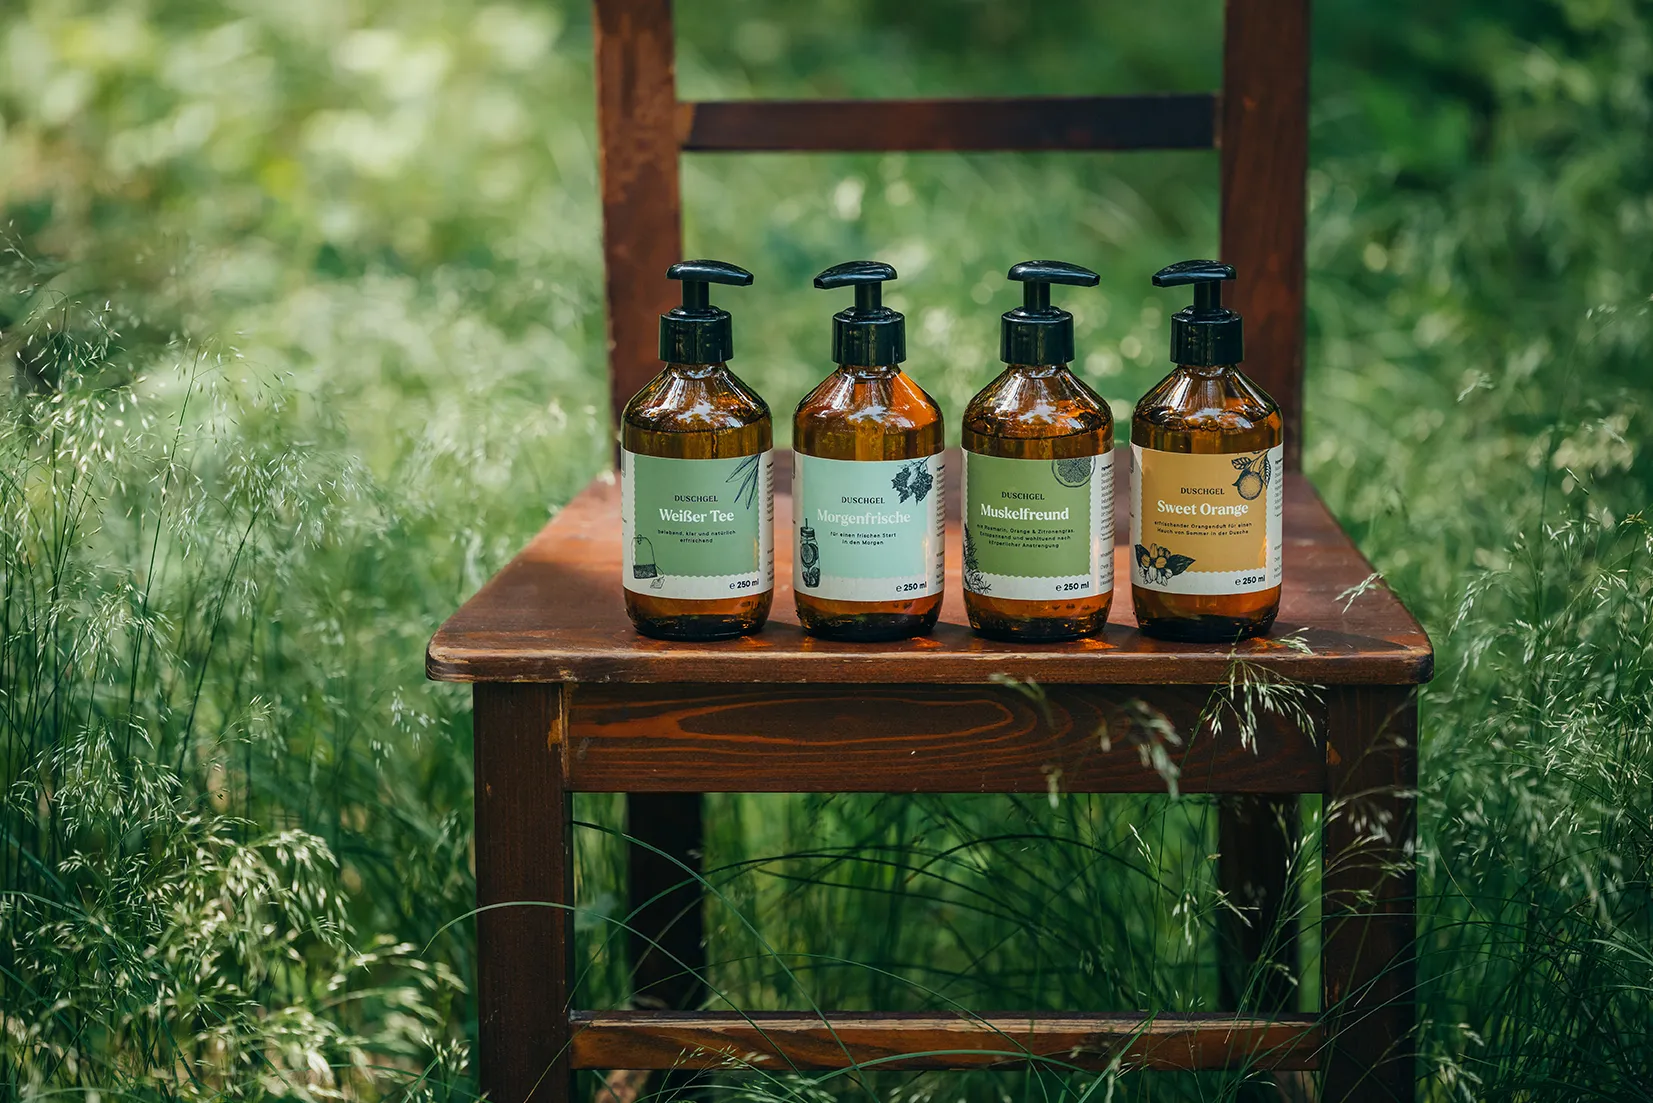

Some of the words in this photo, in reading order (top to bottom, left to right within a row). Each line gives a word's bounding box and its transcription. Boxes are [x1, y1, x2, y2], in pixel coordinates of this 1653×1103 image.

[1001, 491, 1045, 500] DUSCHGEL
[1180, 487, 1224, 495] DUSCHGEL
[674, 494, 718, 502] DUSCHGEL
[842, 496, 886, 504] DUSCHGEL
[980, 503, 1070, 520] Muskelfreund
[1157, 500, 1197, 516] Sweet
[1200, 502, 1248, 518] Orange
[659, 508, 708, 522] Weißer
[710, 509, 734, 522] Tee
[817, 508, 911, 526] Morgenfrische
[737, 580, 750, 590] 250
[752, 578, 760, 586] ml
[1242, 576, 1256, 585] 250
[1258, 574, 1266, 582] ml
[904, 582, 918, 591] 250
[920, 581, 927, 589] ml
[1064, 582, 1079, 591] 250
[1080, 581, 1090, 589] ml
